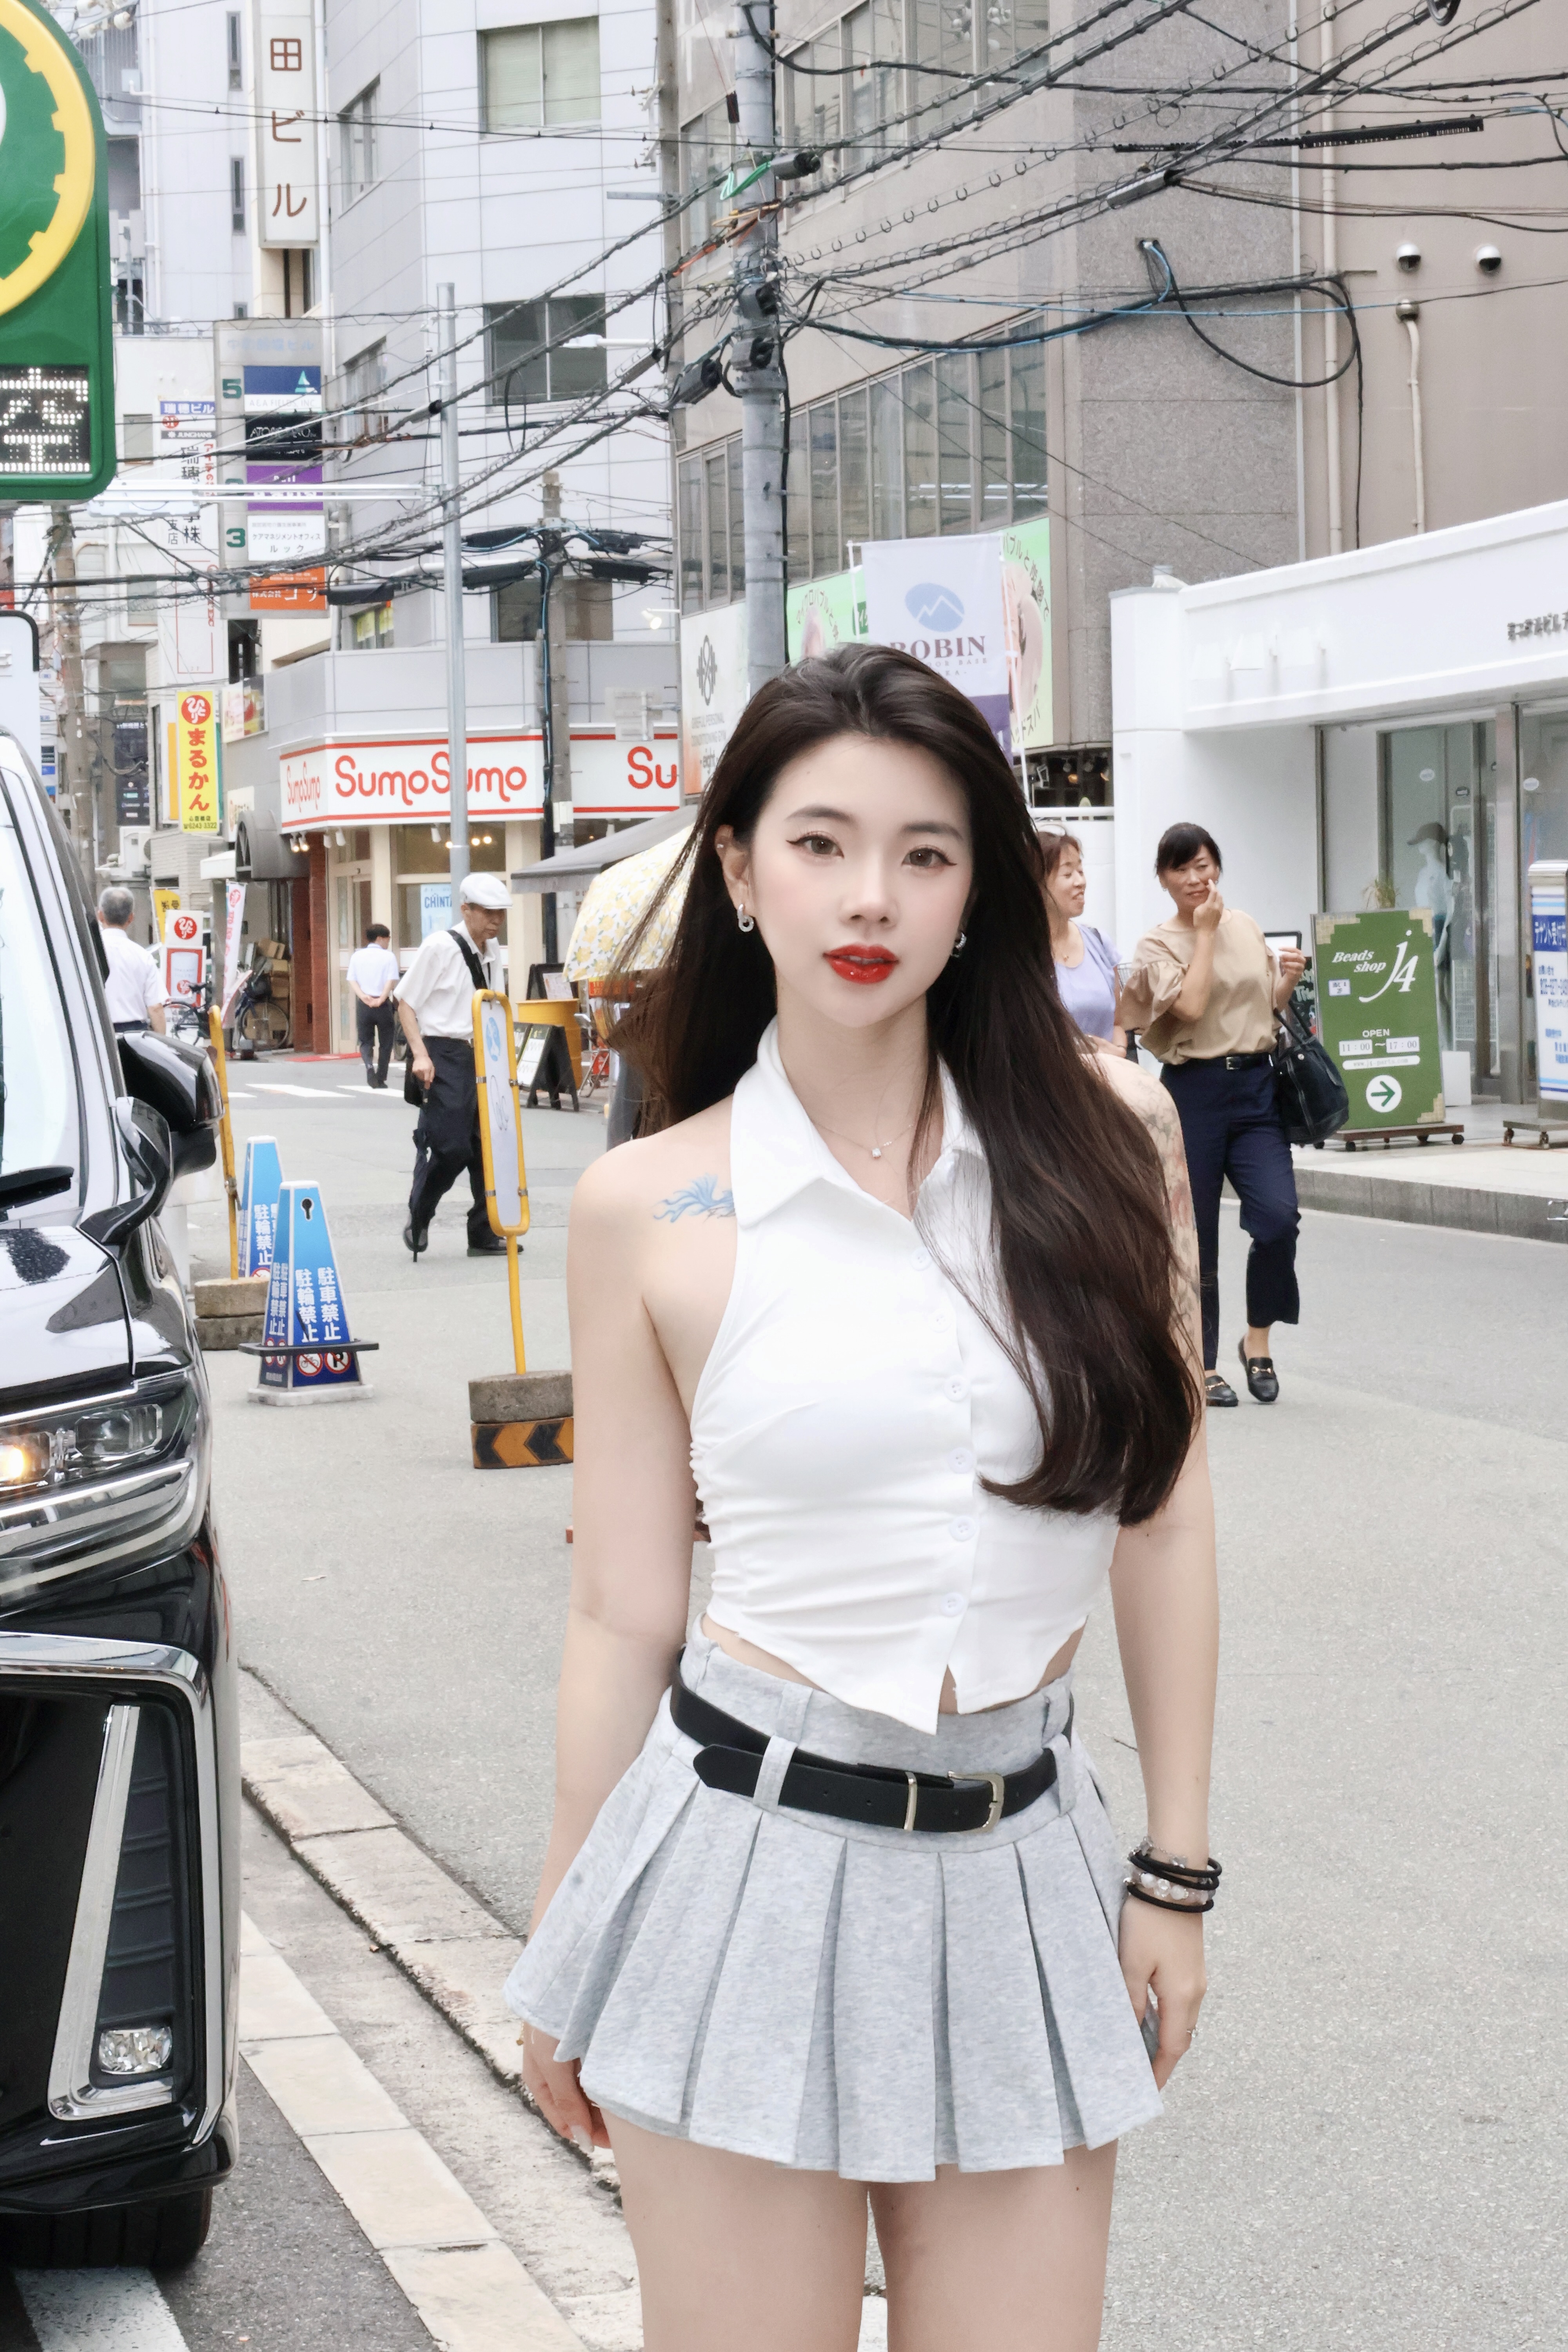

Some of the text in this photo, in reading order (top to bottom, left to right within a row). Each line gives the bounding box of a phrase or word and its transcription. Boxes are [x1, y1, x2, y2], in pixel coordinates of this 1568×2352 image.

[222, 378, 242, 399] 5
[226, 528, 246, 548] 3
[270, 544, 304, 553] ルック
[187, 728, 210, 811] まるかん
[287, 761, 321, 813] SumoSumo
[335, 751, 528, 806] SumoSmo
[1332, 949, 1375, 963] Beads
[1353, 961, 1387, 973] shop
[1362, 1028, 1390, 1038] OPEN
[254, 1204, 273, 1265] 駐輪禁止
[295, 1268, 319, 1343] 駐輪禁止
[318, 1267, 341, 1341] 駐車禁止
